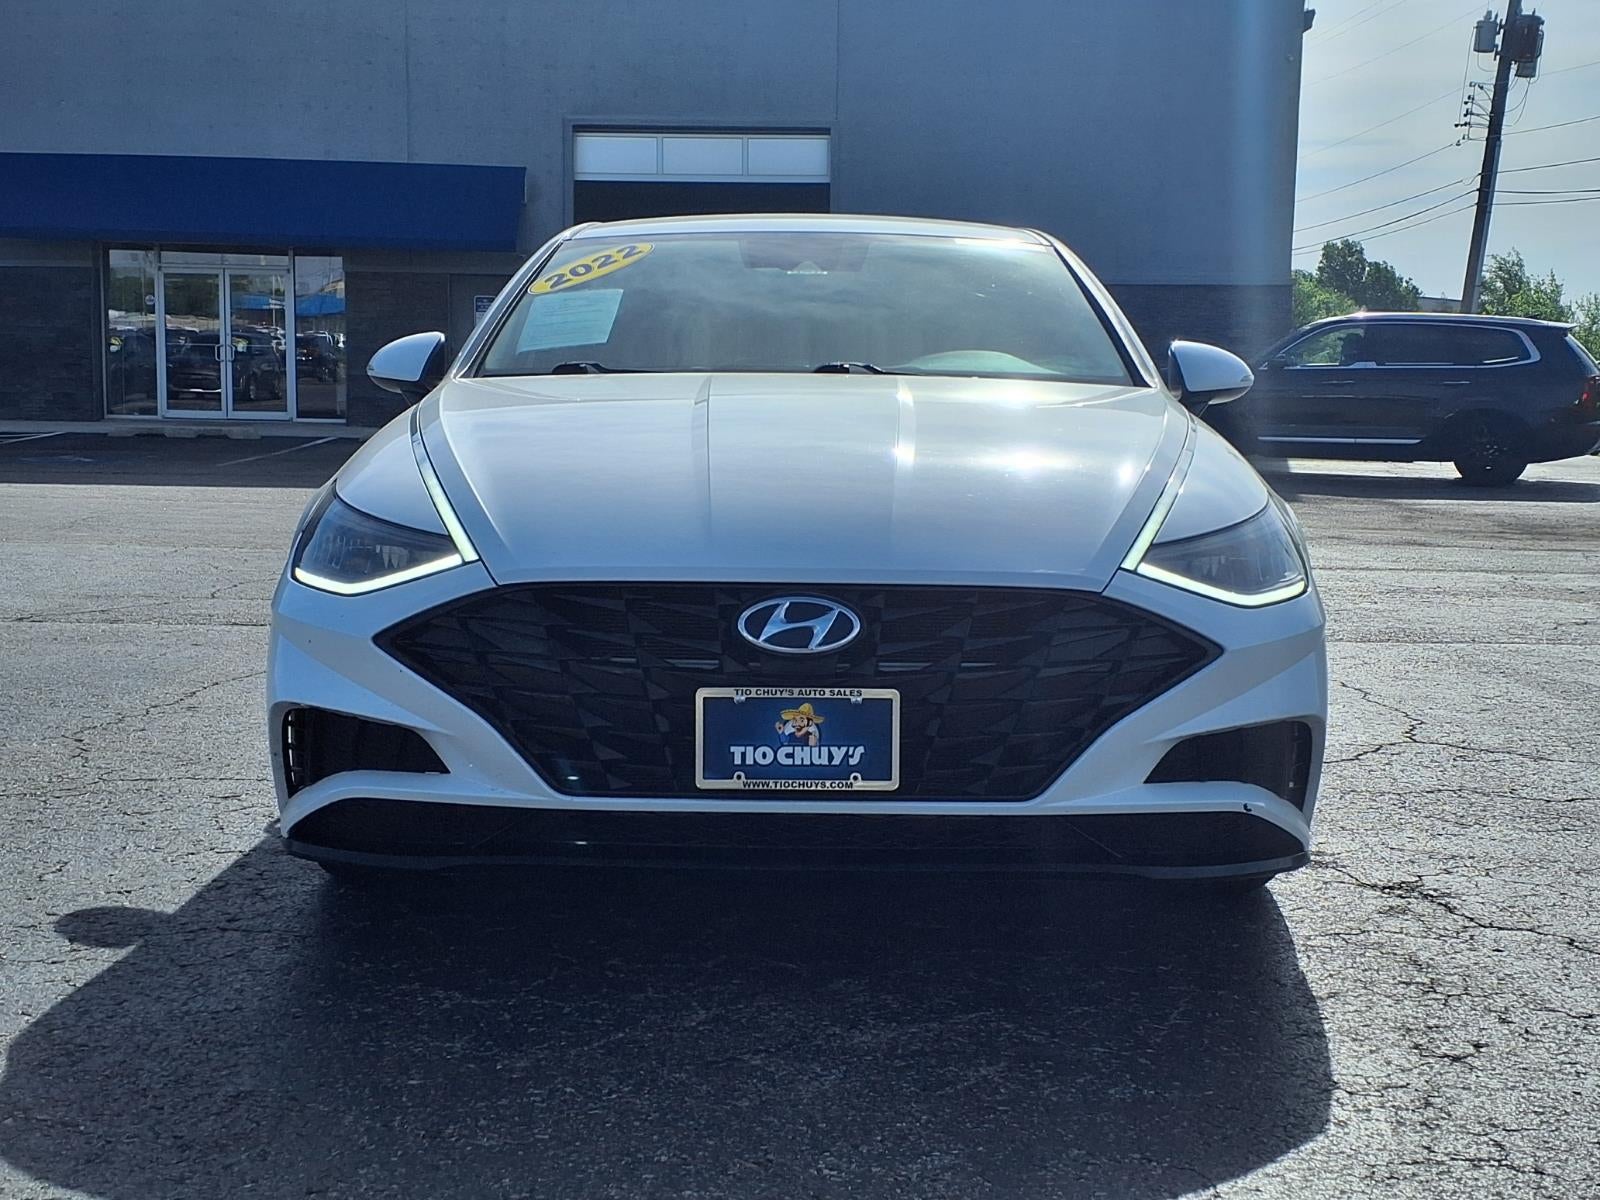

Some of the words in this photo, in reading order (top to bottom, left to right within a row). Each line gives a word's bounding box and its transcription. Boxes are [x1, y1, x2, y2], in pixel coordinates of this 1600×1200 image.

[544, 244, 642, 289] 2022
[734, 688, 752, 696] TIO
[755, 688, 795, 697] CHUY'S
[797, 689, 826, 697] AUTO
[829, 689, 863, 697] SALES
[742, 780, 854, 789] WWW.TIOCHUYS.COM
